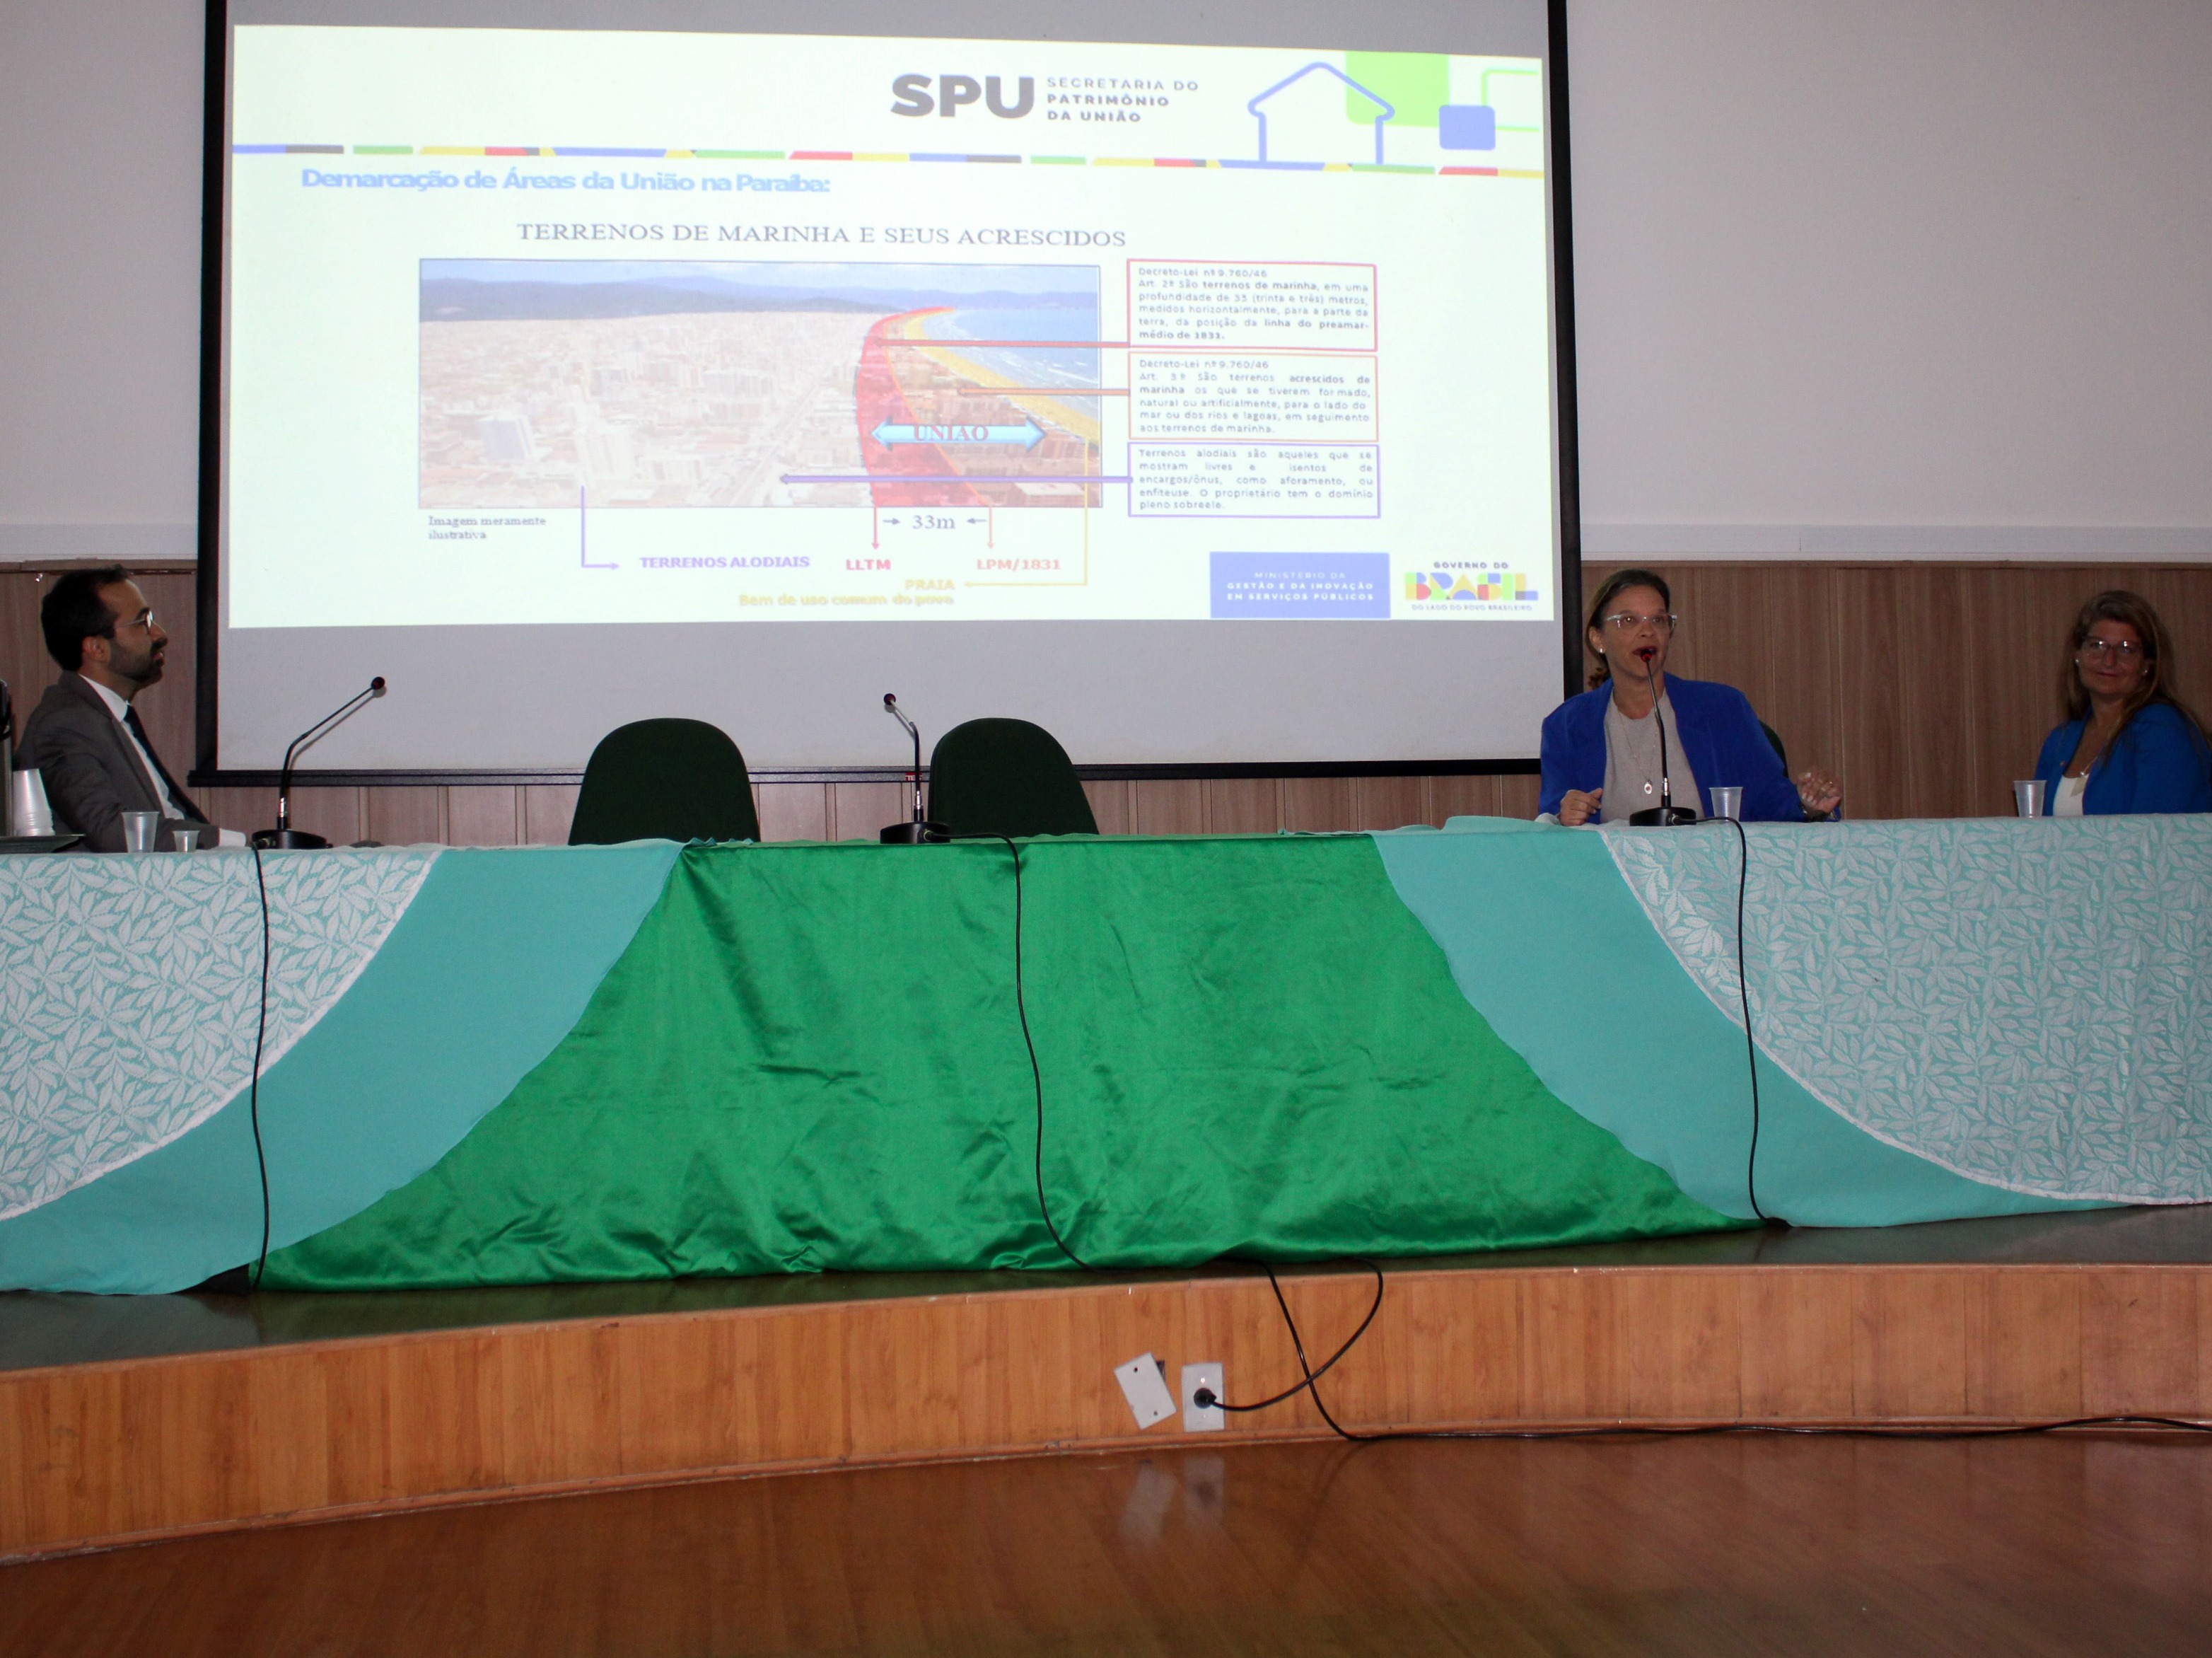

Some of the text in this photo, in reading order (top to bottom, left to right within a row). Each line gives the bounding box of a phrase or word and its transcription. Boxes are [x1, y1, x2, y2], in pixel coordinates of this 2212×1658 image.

[1047, 76, 1199, 91] SECRETARIA DO
[890, 74, 1035, 119] SPU
[1047, 94, 1170, 107] PATRIMÔNIO
[1047, 110, 1141, 122] DA UNIÃO
[301, 169, 460, 192] Demarcação
[465, 170, 497, 190] de
[503, 167, 576, 190] Áreas
[582, 171, 615, 190] da
[621, 173, 694, 192] União
[702, 177, 733, 192] na
[517, 223, 1127, 248] TERRENOS DE MARINHA E SEUS ACRESCIDOS
[1139, 267, 1198, 276] Decreto-Lei
[1218, 269, 1267, 278] 9.760/46
[1255, 281, 1268, 289] de
[1272, 282, 1320, 291] marinha,
[1346, 283, 1368, 291] uma
[1139, 292, 1211, 303] profundidade
[1216, 293, 1230, 301] de
[1252, 294, 1284, 303] (trinta
[1329, 296, 1368, 306] metros,
[1189, 305, 1279, 315] horizontalmente,
[1284, 307, 1308, 316] para
[1323, 308, 1351, 317] parte
[1355, 308, 1368, 317] da
[1139, 318, 1168, 327] terra,
[1176, 318, 1189, 326] da
[1244, 318, 1257, 327] da
[1264, 319, 1291, 327] linha
[1298, 320, 1312, 328] do
[1319, 320, 1369, 330] preamar-
[1139, 330, 1174, 339] médio
[1177, 330, 1191, 339] de
[1140, 359, 1199, 368] Decreto-Lei
[1219, 361, 1269, 369] 9.760/46
[1230, 373, 1274, 382] terrenos
[1290, 375, 1344, 383] acrescidos
[1140, 385, 1184, 394] marinha
[1217, 387, 1237, 395] que
[1269, 387, 1310, 395] tiverem
[1201, 399, 1280, 409] artificialmente,
[1284, 400, 1308, 409] para
[1325, 401, 1348, 410] lado
[1353, 402, 1366, 410] do
[1244, 411, 1281, 421] lagoas,
[1307, 412, 1369, 422] seguimento
[1162, 424, 1206, 432] terrenos
[1211, 424, 1224, 432] de
[1226, 424, 1274, 433] marinha.
[1139, 448, 1187, 458] Terrenos
[1197, 449, 1237, 458] alodiais
[1247, 448, 1267, 458] são
[1278, 450, 1319, 460] aqueles
[1329, 451, 1349, 460] que
[1205, 463, 1233, 471] livres
[1289, 463, 1327, 473] isentos
[1359, 463, 1373, 473] de
[1139, 475, 1223, 485] encargos/ônus,
[1280, 476, 1346, 487] aforamento,
[1200, 489, 1208, 497] O
[1215, 489, 1281, 499] proprietário
[1288, 489, 1308, 498] tem
[1139, 501, 1170, 510] pleno
[428, 516, 547, 527] Imagem meramente
[912, 515, 956, 530] 33m
[428, 530, 487, 540] ilustrativa
[640, 557, 810, 569] TERRENOS ALODIAIS
[845, 560, 891, 570] LLTM
[977, 559, 1060, 572] LPM/1831
[904, 580, 955, 590] PRAIA
[1311, 581, 1373, 591] INOVAÇÃO
[1404, 572, 1539, 601] BRASIL
[739, 595, 773, 605] Bem
[779, 594, 796, 605] de
[801, 596, 828, 605] uso
[832, 596, 887, 605] comum
